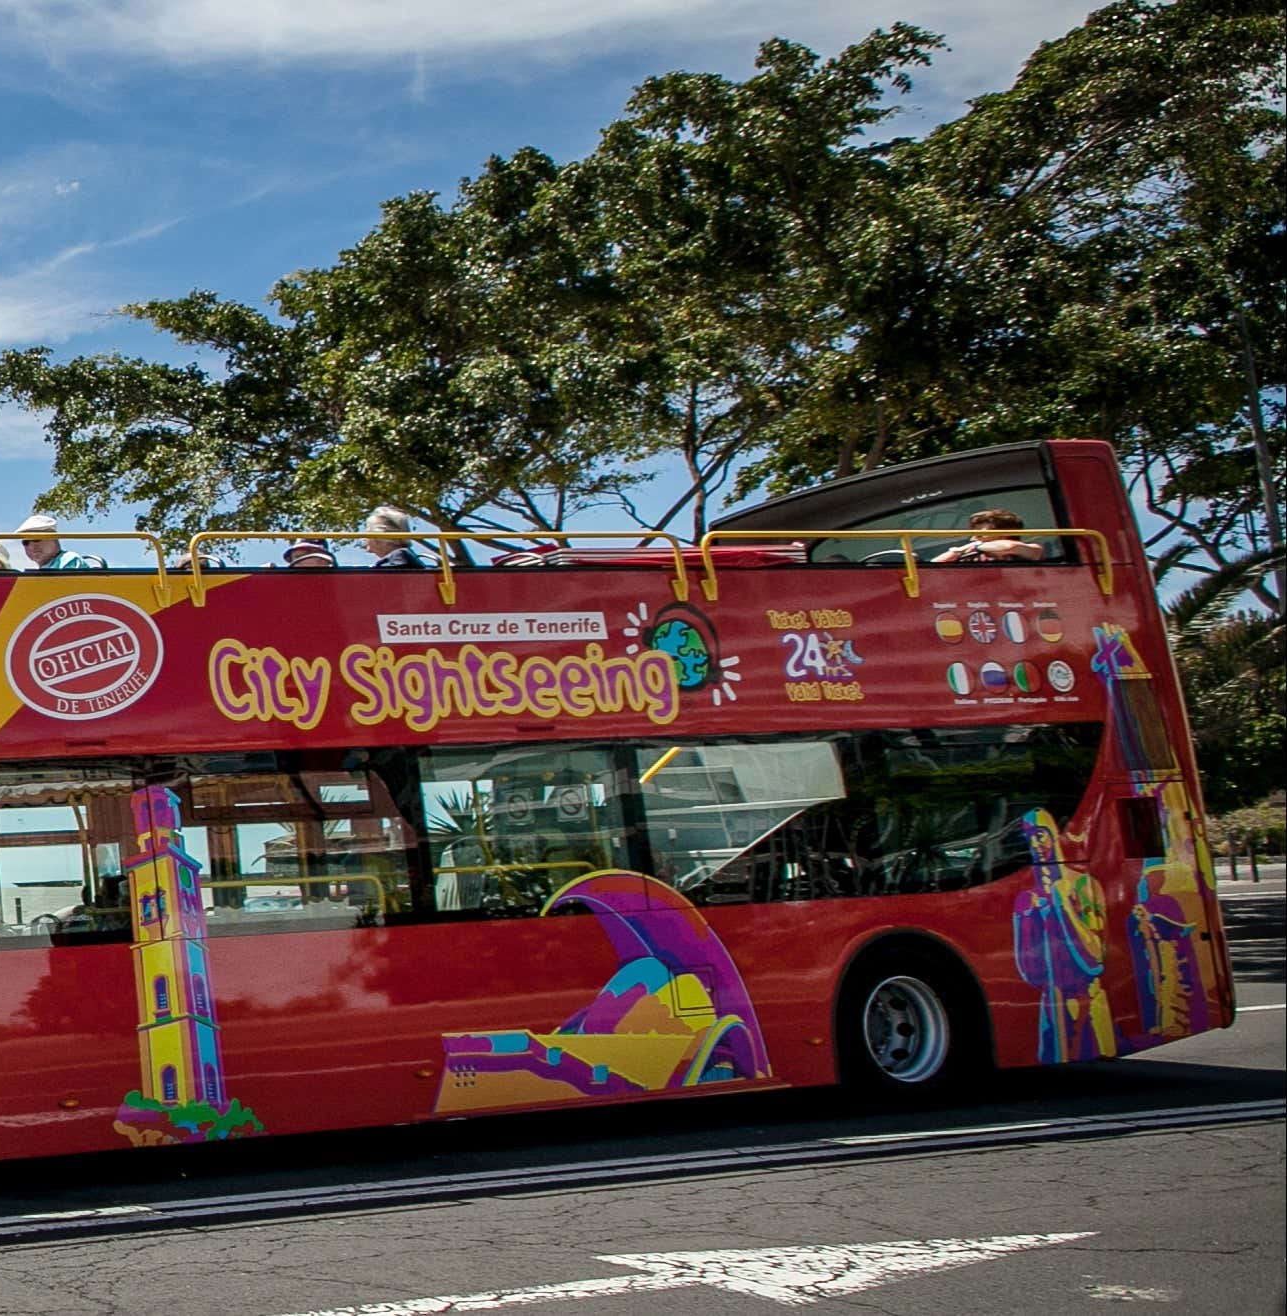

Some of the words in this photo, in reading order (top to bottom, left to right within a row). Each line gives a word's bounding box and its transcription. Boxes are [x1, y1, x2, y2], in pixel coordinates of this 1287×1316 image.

[43, 601, 93, 625] TOUR
[386, 620, 439, 636] Santa
[448, 619, 490, 636] Cruz
[497, 618, 519, 635] de
[526, 617, 601, 635] Tenerife
[38, 636, 134, 679] OFICIAL
[782, 633, 826, 677] 24
[56, 699, 80, 714] DE
[85, 668, 149, 712] TENERIFE
[209, 638, 331, 730] City
[339, 644, 680, 731] Sightseeing
